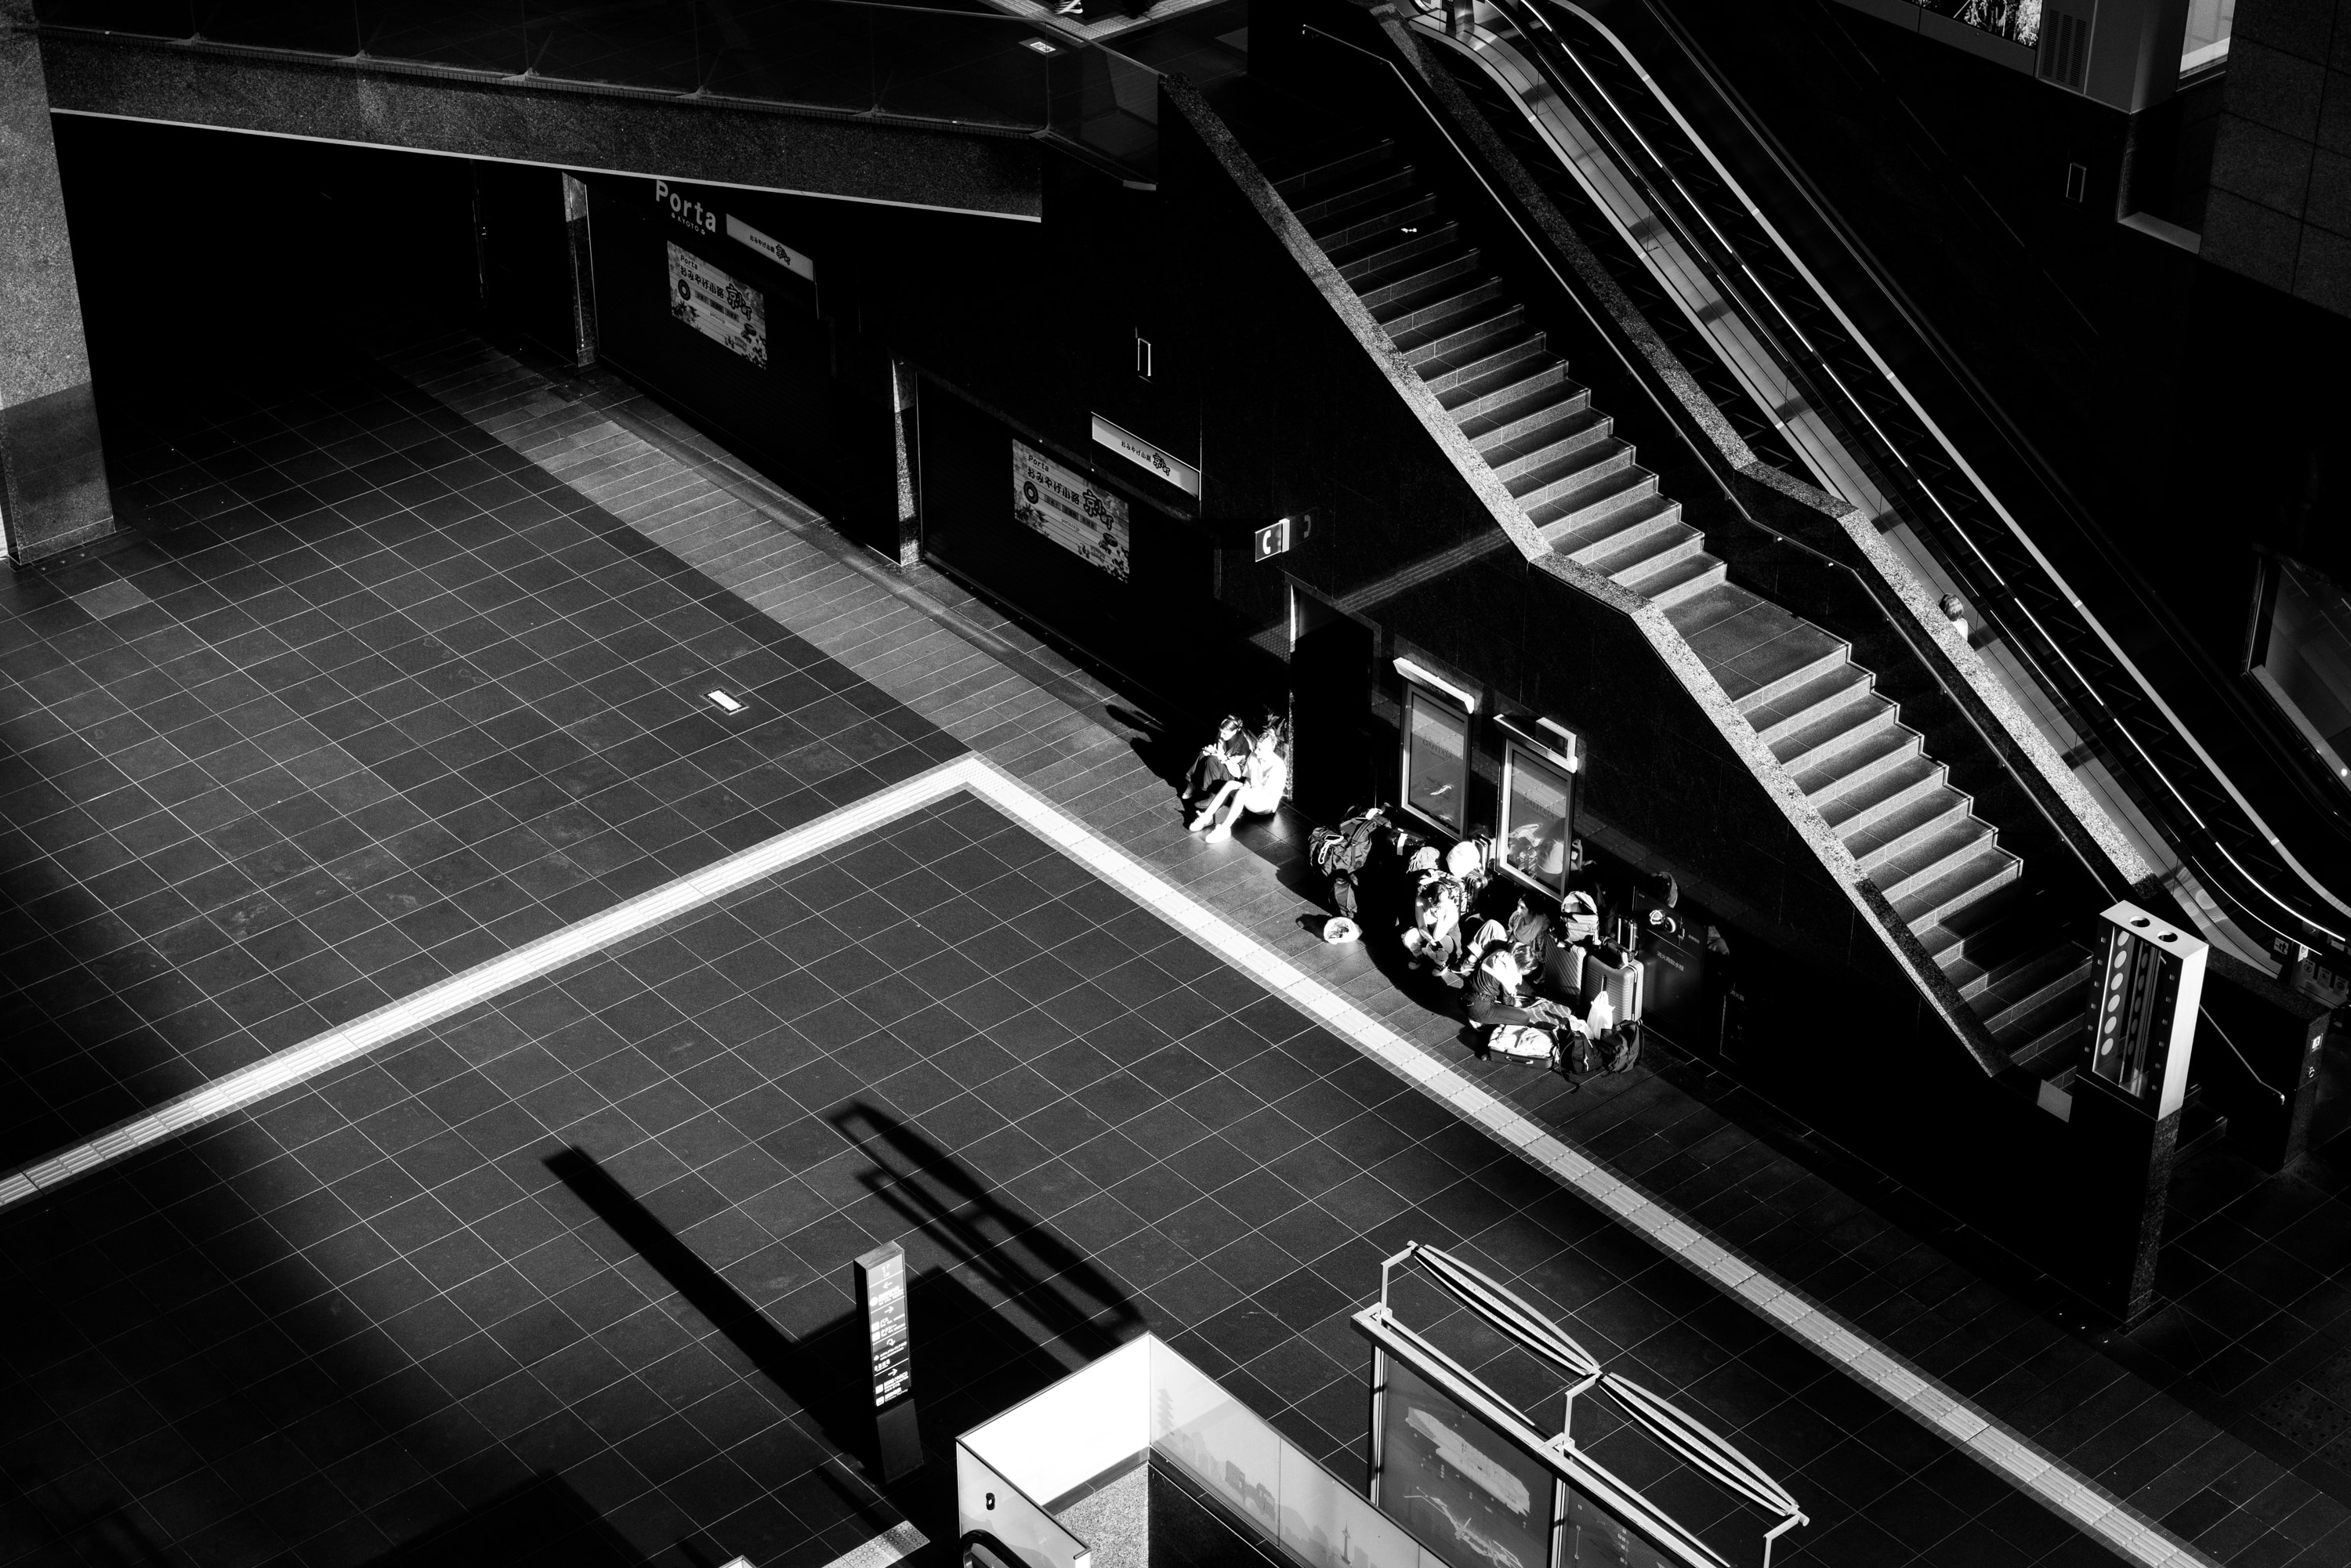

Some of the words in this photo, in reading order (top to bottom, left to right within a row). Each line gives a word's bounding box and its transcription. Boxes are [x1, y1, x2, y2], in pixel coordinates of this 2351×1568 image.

[655, 179, 716, 233] Porta
[677, 215, 699, 232] KYOTO
[680, 255, 698, 270] Porta
[680, 266, 724, 299] おみやげ小路
[1028, 454, 1049, 472] Porta
[1027, 466, 1080, 505] おみやげ小路
